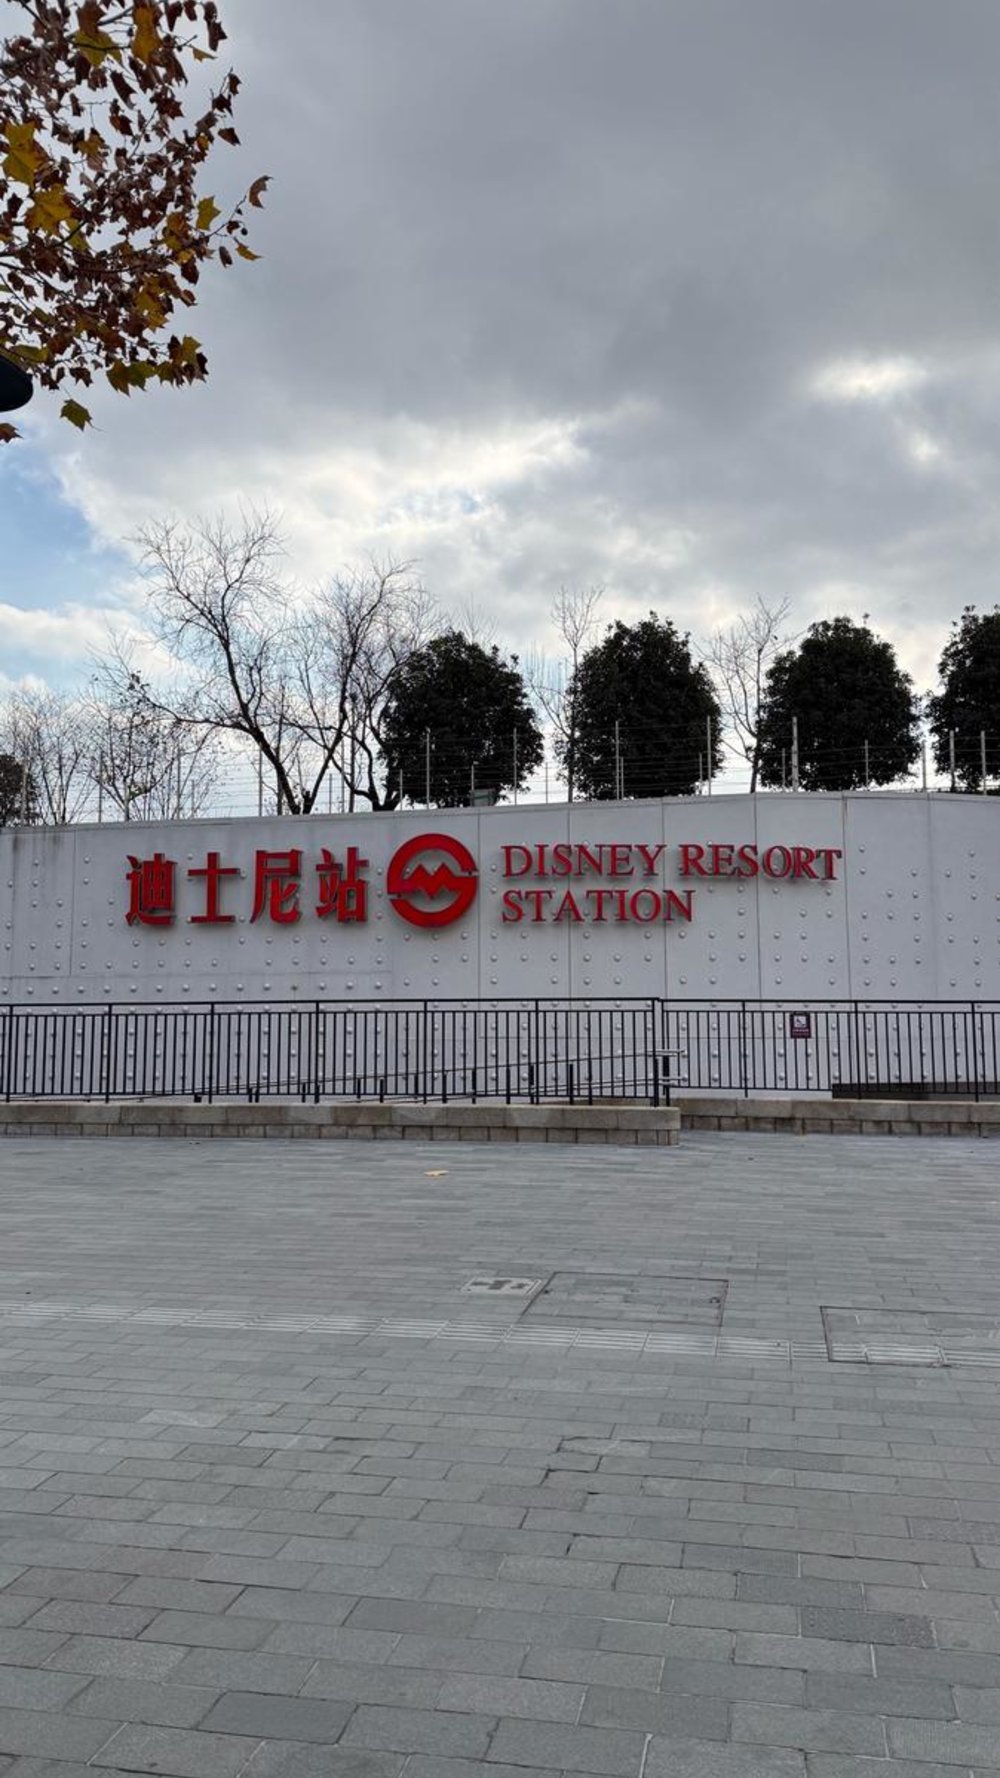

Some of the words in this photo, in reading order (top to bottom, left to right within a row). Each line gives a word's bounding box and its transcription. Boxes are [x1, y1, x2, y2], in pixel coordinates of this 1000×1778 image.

[501, 844, 667, 877] DISNEY
[679, 844, 842, 880] RESORT
[125, 847, 369, 925] 迪士尼站
[502, 889, 696, 922] STATION
